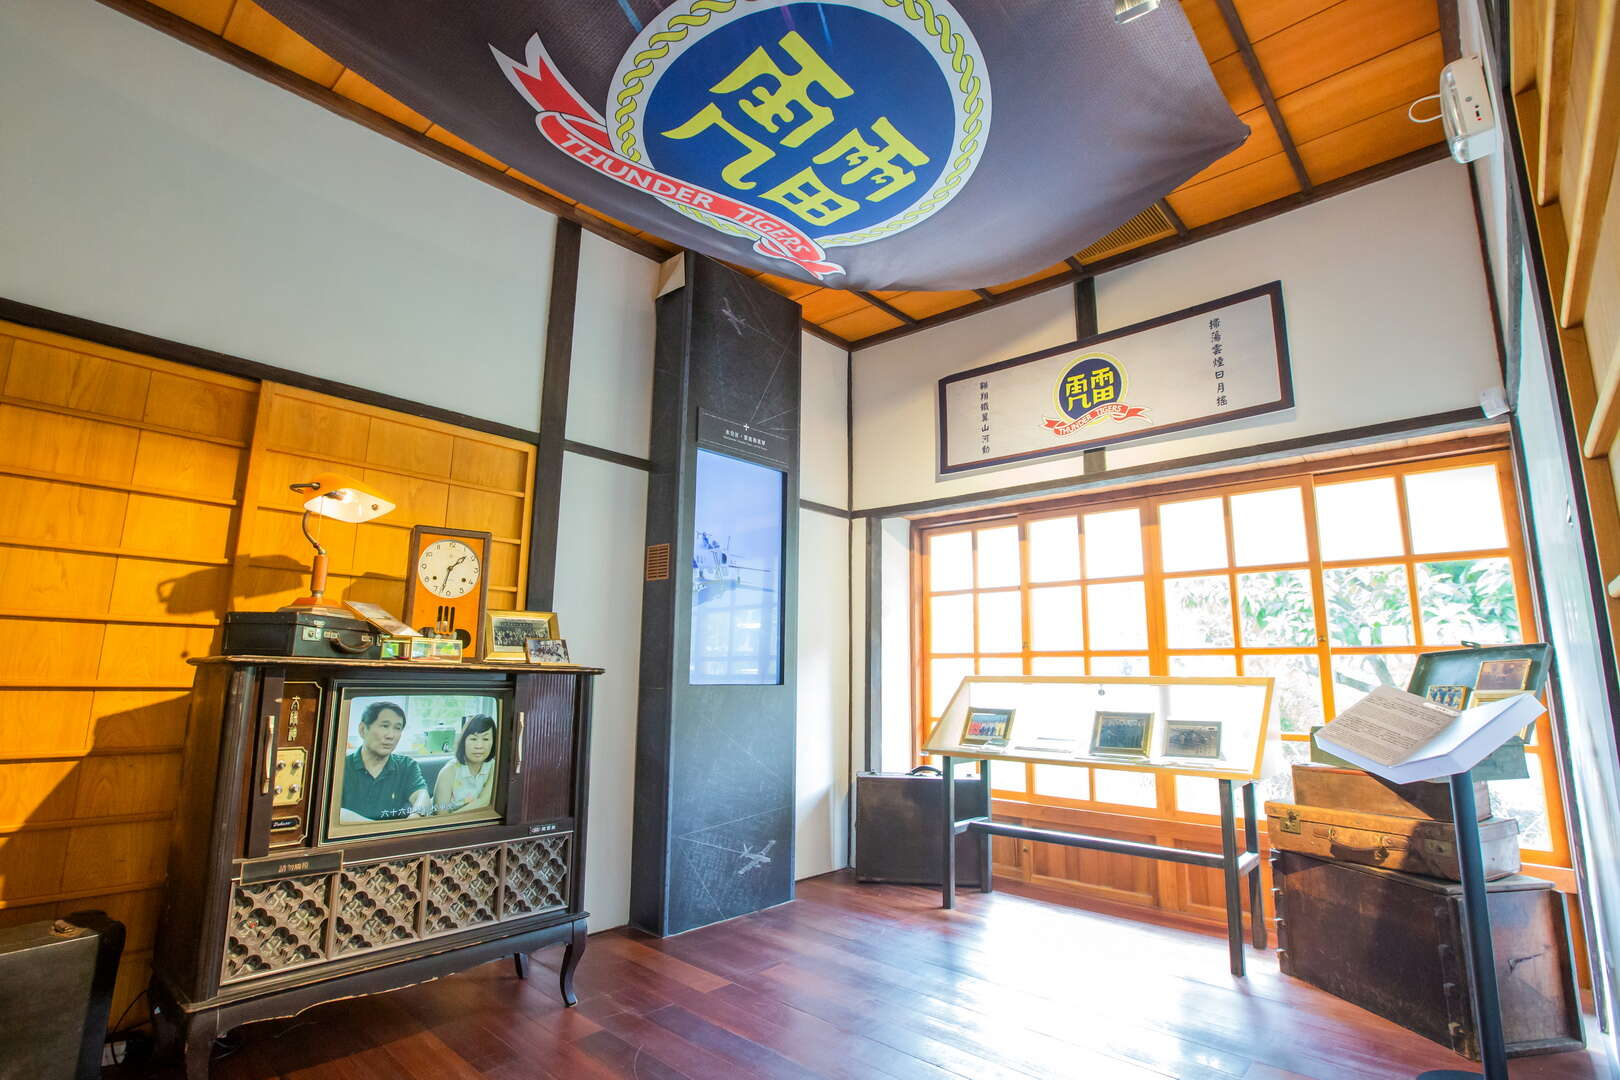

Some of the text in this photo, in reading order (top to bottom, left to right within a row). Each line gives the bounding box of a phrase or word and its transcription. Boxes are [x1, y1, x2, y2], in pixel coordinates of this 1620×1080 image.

[560, 133, 812, 254] THUNDER TIGERS
[1060, 405, 1122, 435] THUNDER TIGERS
